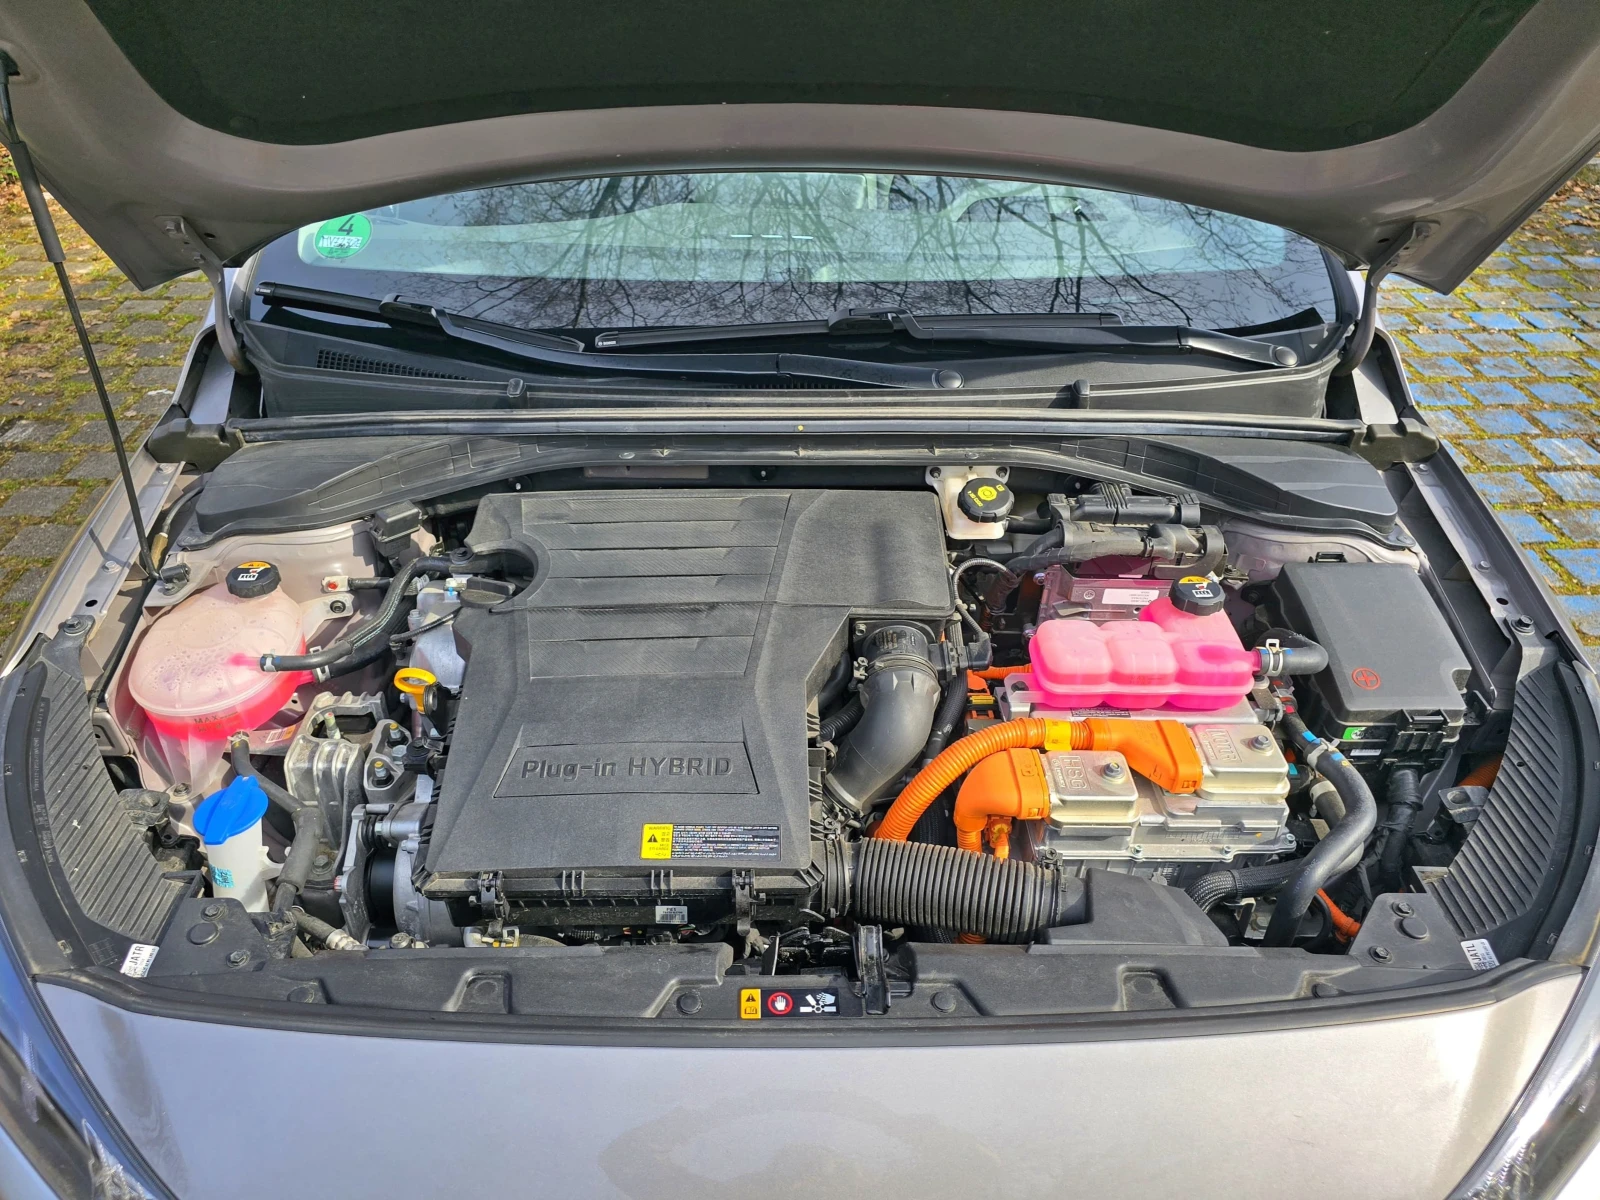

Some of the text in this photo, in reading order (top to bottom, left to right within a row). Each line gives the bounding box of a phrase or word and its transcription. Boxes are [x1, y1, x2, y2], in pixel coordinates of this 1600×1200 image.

[337, 214, 355, 236] 4
[194, 714, 218, 724] MAX
[521, 756, 733, 782] Plug-in HYBRID
[1064, 759, 1087, 788] HSG
[129, 945, 146, 966] JATR
[1465, 943, 1482, 962] JATL
